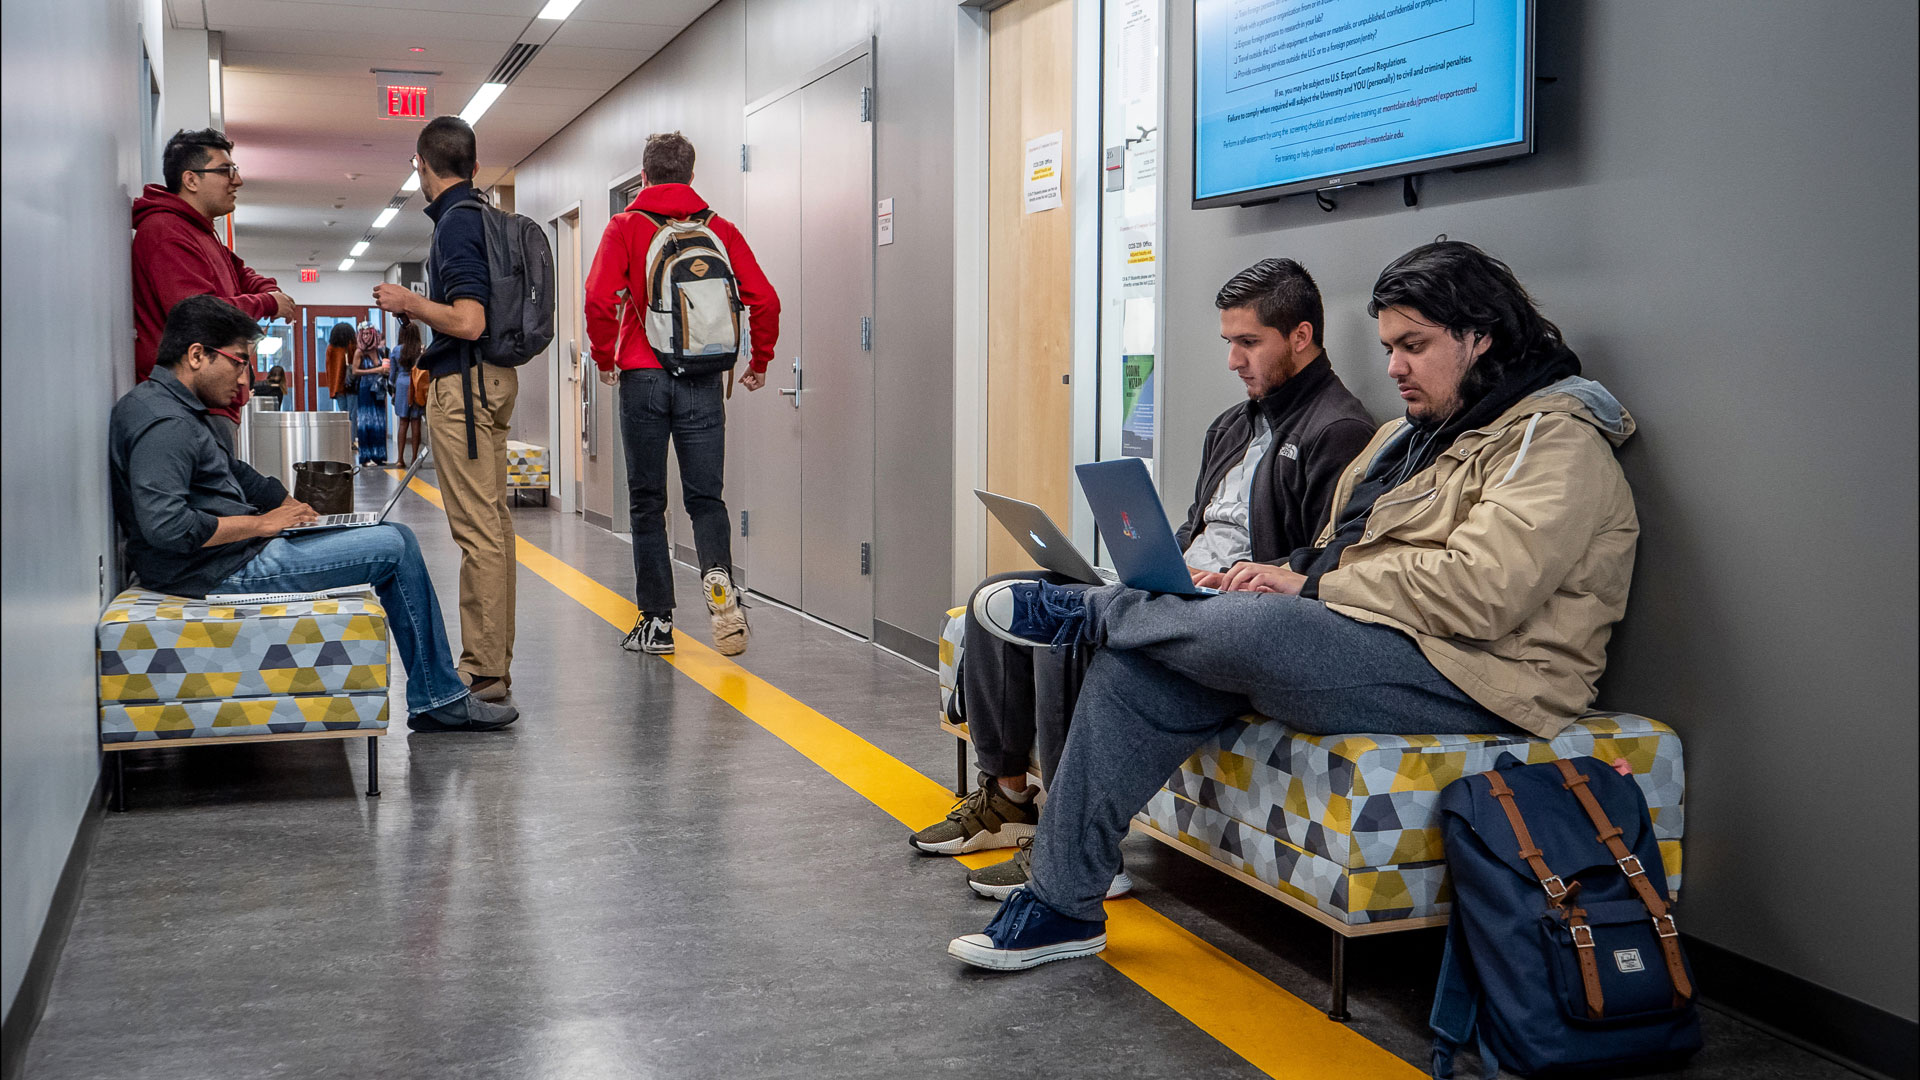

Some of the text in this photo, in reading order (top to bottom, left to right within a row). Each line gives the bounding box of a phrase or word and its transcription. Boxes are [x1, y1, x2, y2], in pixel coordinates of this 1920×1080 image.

[1238, 39, 1250, 48] Expose
[1265, 30, 1279, 41] persons
[1284, 21, 1300, 32] research
[1305, 19, 1314, 28] your
[1314, 13, 1323, 24] lab?
[1238, 52, 1248, 62] Travel
[1248, 49, 1262, 59] outside
[1277, 41, 1285, 50] with
[1308, 31, 1326, 40] software
[1387, 2, 1414, 16] confidential
[1238, 68, 1251, 77] Provide
[1252, 64, 1270, 73] consulting
[1270, 60, 1285, 68] services
[1286, 54, 1300, 63] outside
[1330, 42, 1345, 50] foreign
[1227, 114, 1240, 122] Failure
[1246, 108, 1259, 118] comply
[1260, 106, 1270, 114] when
[1270, 100, 1288, 113] required
[1296, 96, 1311, 106] subject
[1320, 88, 1343, 99] University
[1344, 84, 1352, 93] and
[1353, 81, 1366, 91] YOU
[1366, 74, 1395, 90] (personally)
[1402, 69, 1413, 78] civil
[1414, 67, 1424, 76] and
[1424, 61, 1445, 73] criminal
[1446, 57, 1472, 70] penalties.
[1274, 88, 1278, 97] If
[1308, 78, 1324, 88] subject
[1341, 70, 1356, 80] Export
[1357, 63, 1375, 75] Control
[1377, 58, 1407, 71] Regulations.
[387, 85, 427, 118] EXIT
[1240, 133, 1266, 144] self-assessment
[1266, 132, 1271, 140] by
[1290, 124, 1307, 133] screening
[1308, 120, 1324, 129] checklist
[1334, 114, 1347, 123] attend
[1361, 109, 1376, 118] training
[1311, 148, 1323, 158] please
[1324, 144, 1335, 152] email
[301, 269, 317, 282] EXIT
